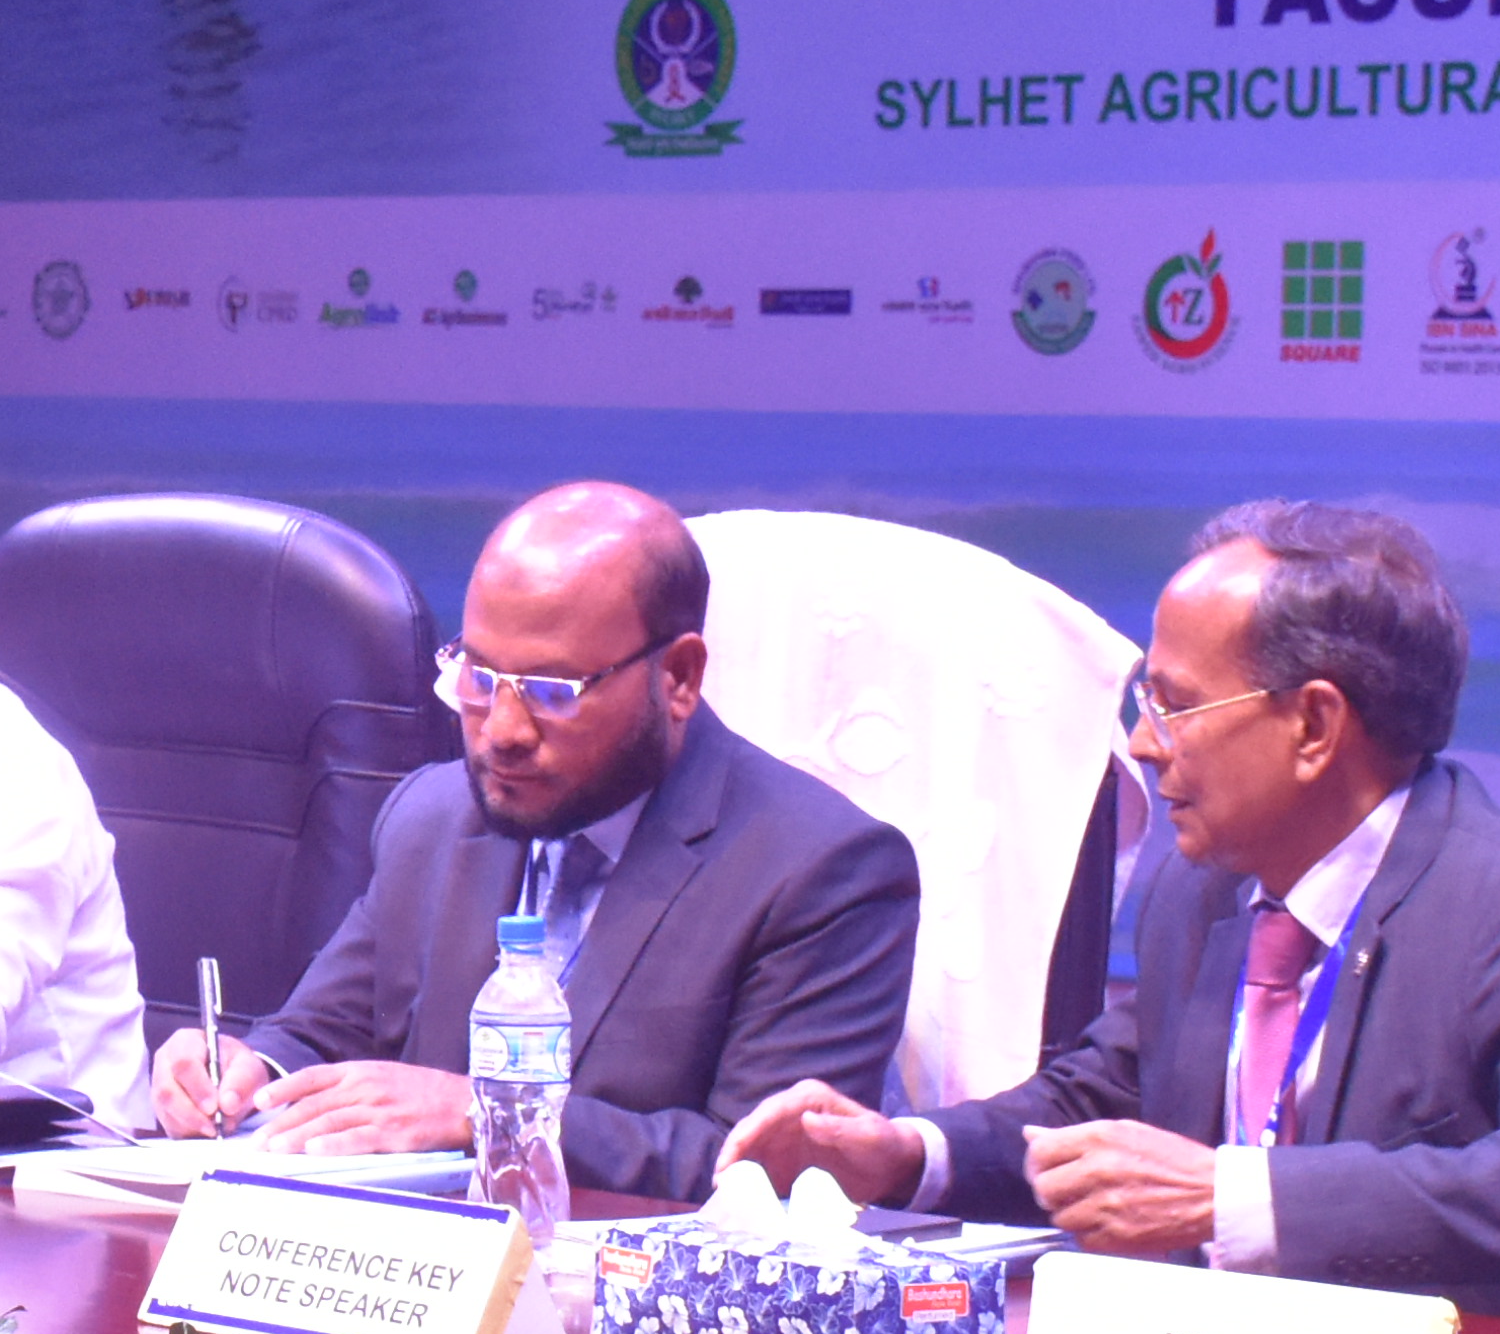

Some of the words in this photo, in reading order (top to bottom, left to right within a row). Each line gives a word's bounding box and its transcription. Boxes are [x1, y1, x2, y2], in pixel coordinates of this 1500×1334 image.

[874, 73, 1084, 132] SYLHET
[1279, 344, 1361, 363] SQUARE
[218, 1229, 403, 1284] CONFERENCE
[407, 1262, 465, 1293] KEY
[219, 1268, 292, 1304] NOTE
[299, 1282, 429, 1329] SPEAKER
[907, 1286, 963, 1303] Bashundhara
